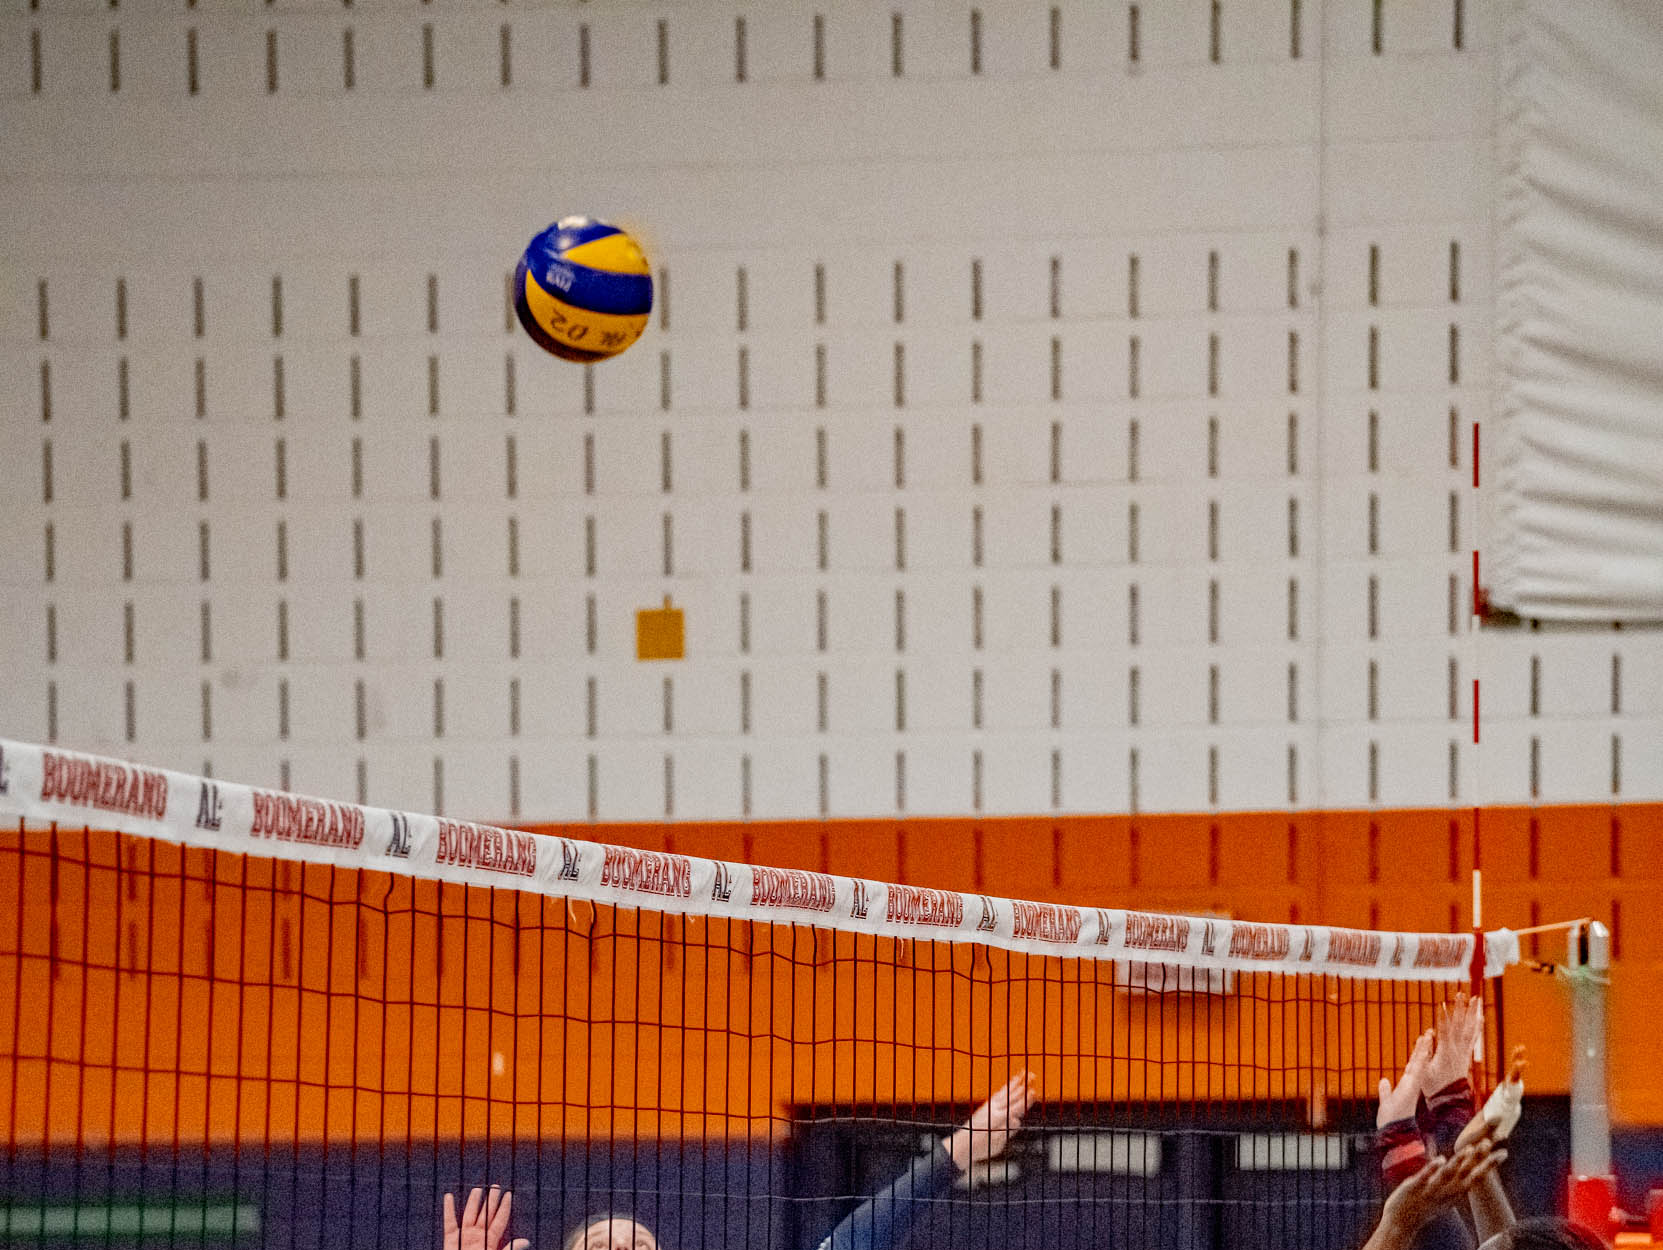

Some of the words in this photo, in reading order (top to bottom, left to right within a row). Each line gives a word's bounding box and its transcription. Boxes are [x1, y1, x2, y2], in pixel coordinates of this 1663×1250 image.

[41, 752, 168, 822] BOOMERANG
[250, 792, 365, 850] BOOMERANG
[435, 819, 537, 877] BOOMERANG
[600, 846, 691, 897] BOOMERANG
[750, 867, 835, 912] BOOMERANG
[886, 885, 963, 927] BOOMERANG
